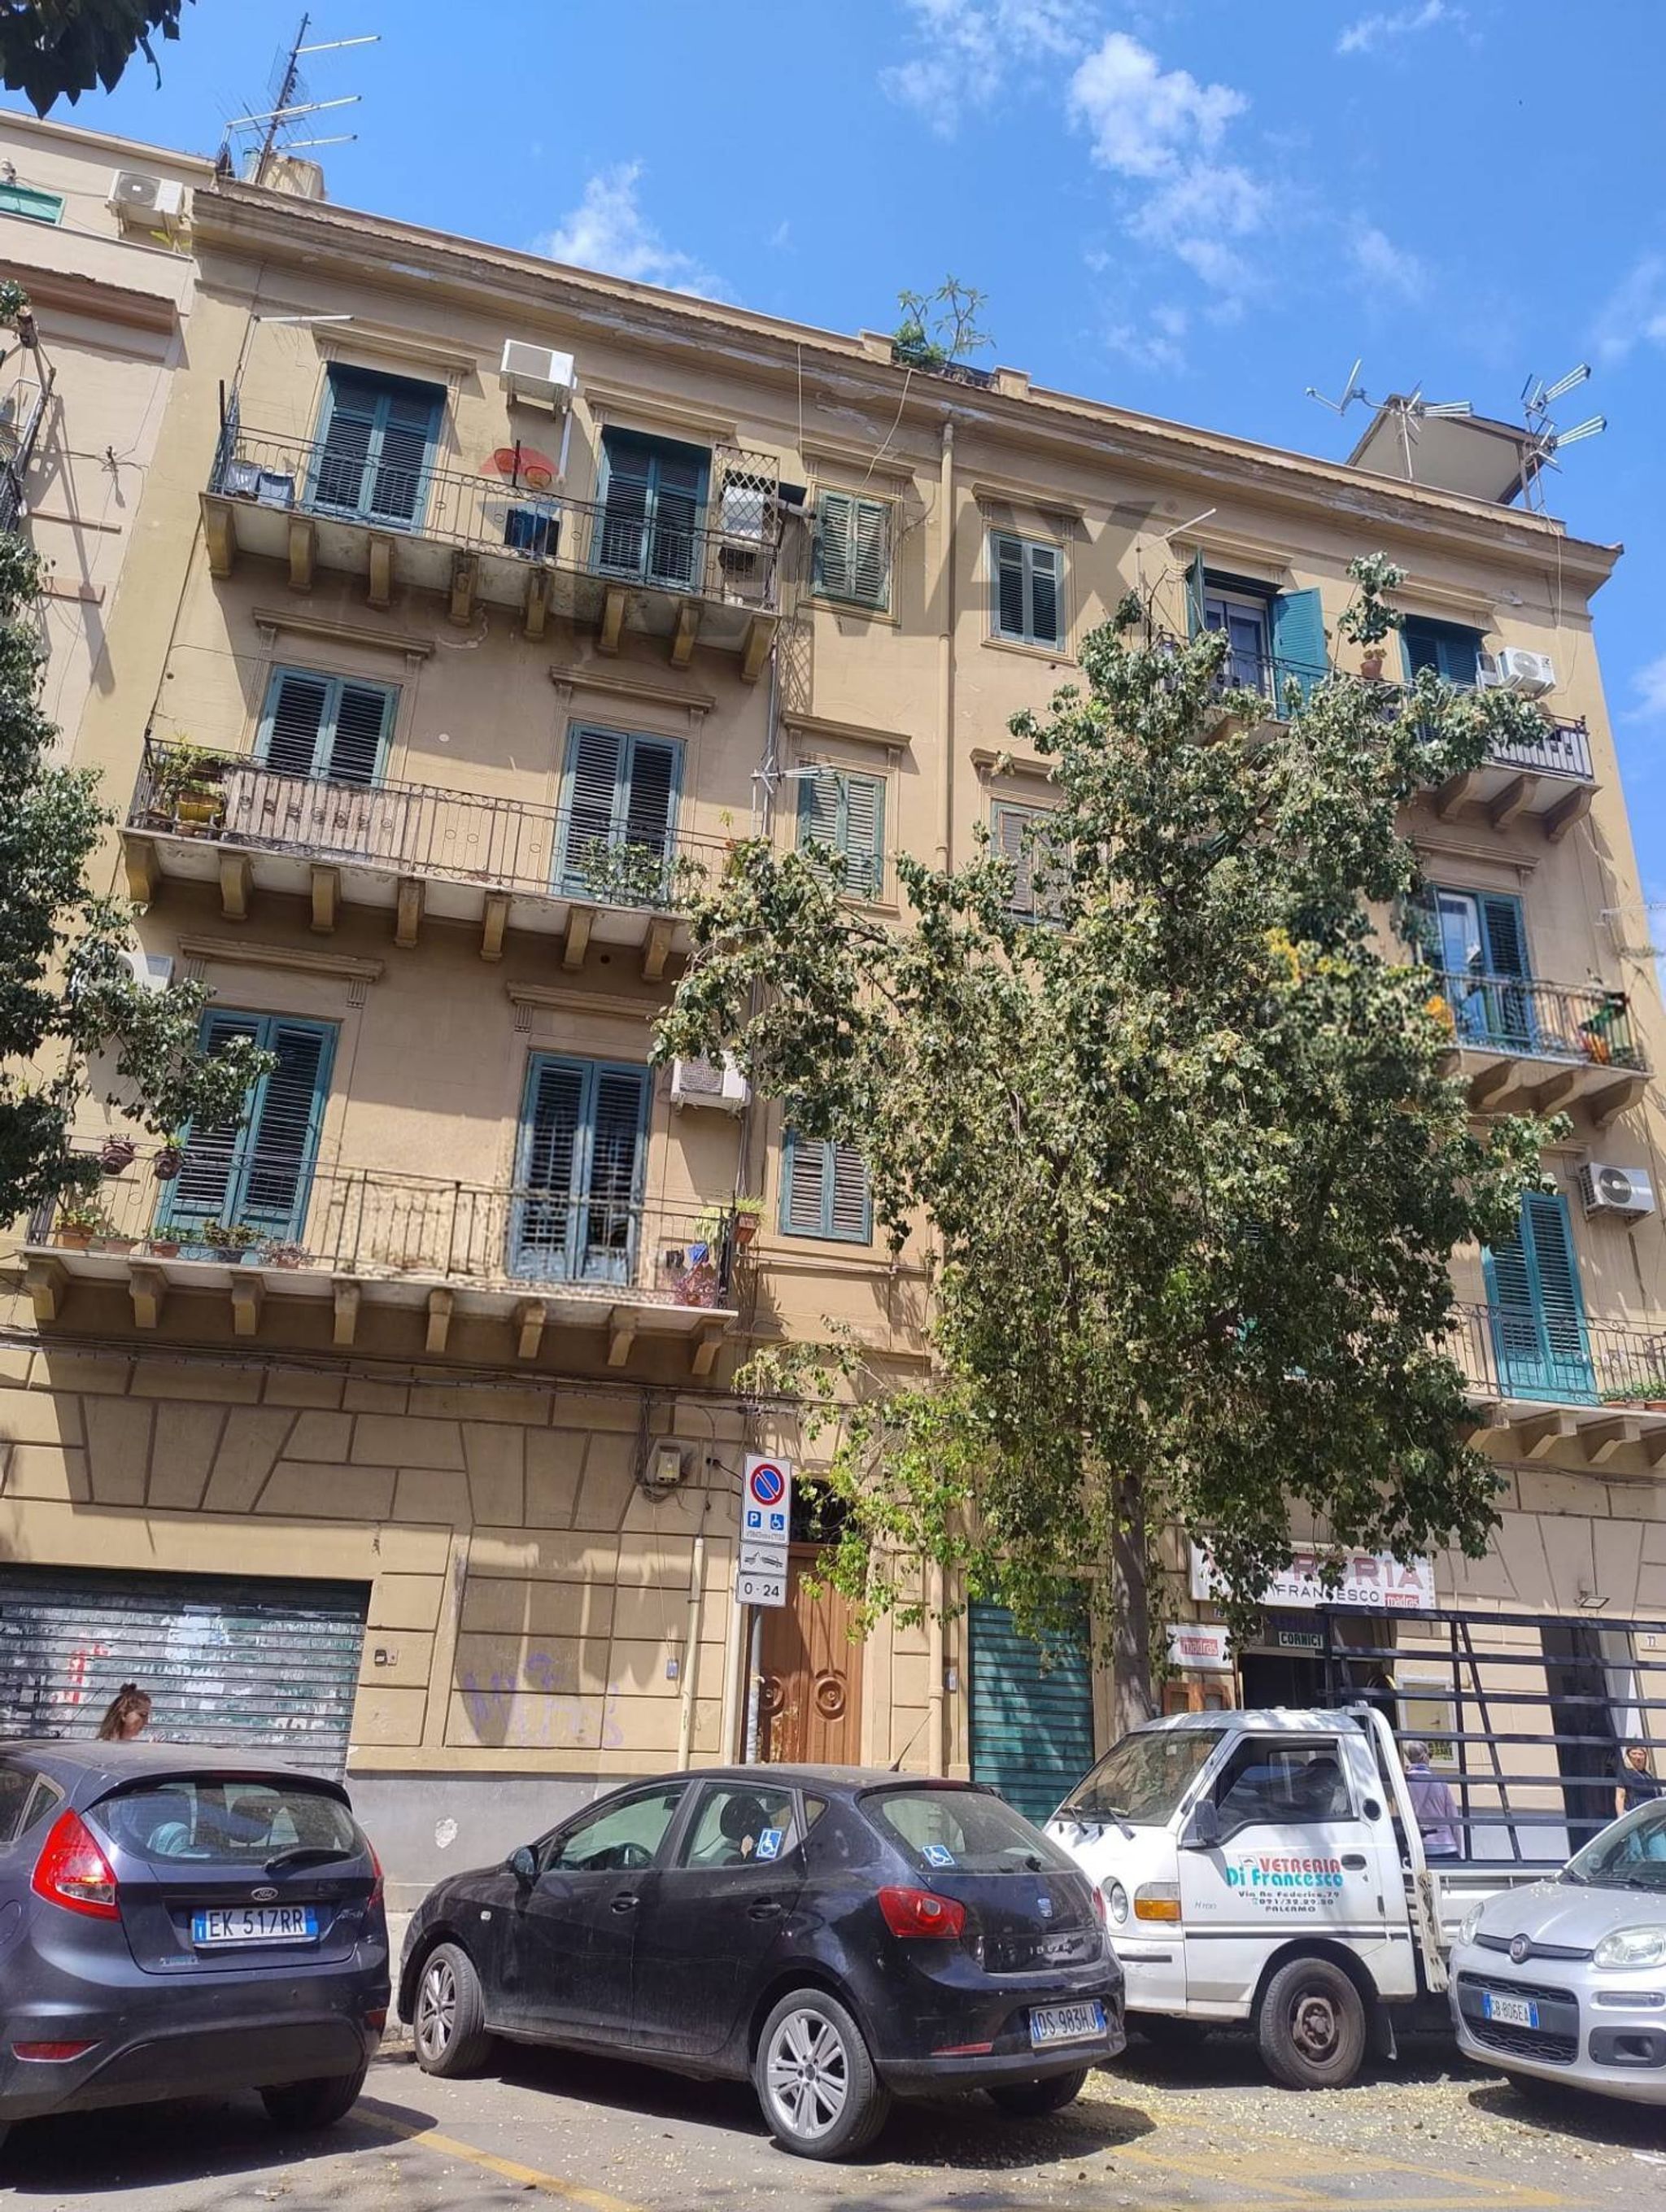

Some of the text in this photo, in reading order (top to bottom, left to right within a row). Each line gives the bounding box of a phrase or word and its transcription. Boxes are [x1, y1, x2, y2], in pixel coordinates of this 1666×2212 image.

[763, 1584, 780, 1597] 24
[1276, 1584, 1380, 1603] FRANESCO
[1183, 1639, 1218, 1655] madras
[1259, 1858, 1341, 1873] VETRERIA
[1226, 1866, 1343, 1887] Di Francesco
[209, 1912, 233, 1938] EK
[243, 1909, 304, 1935] 517RR
[1037, 2005, 1097, 2036] DS 983HJ
